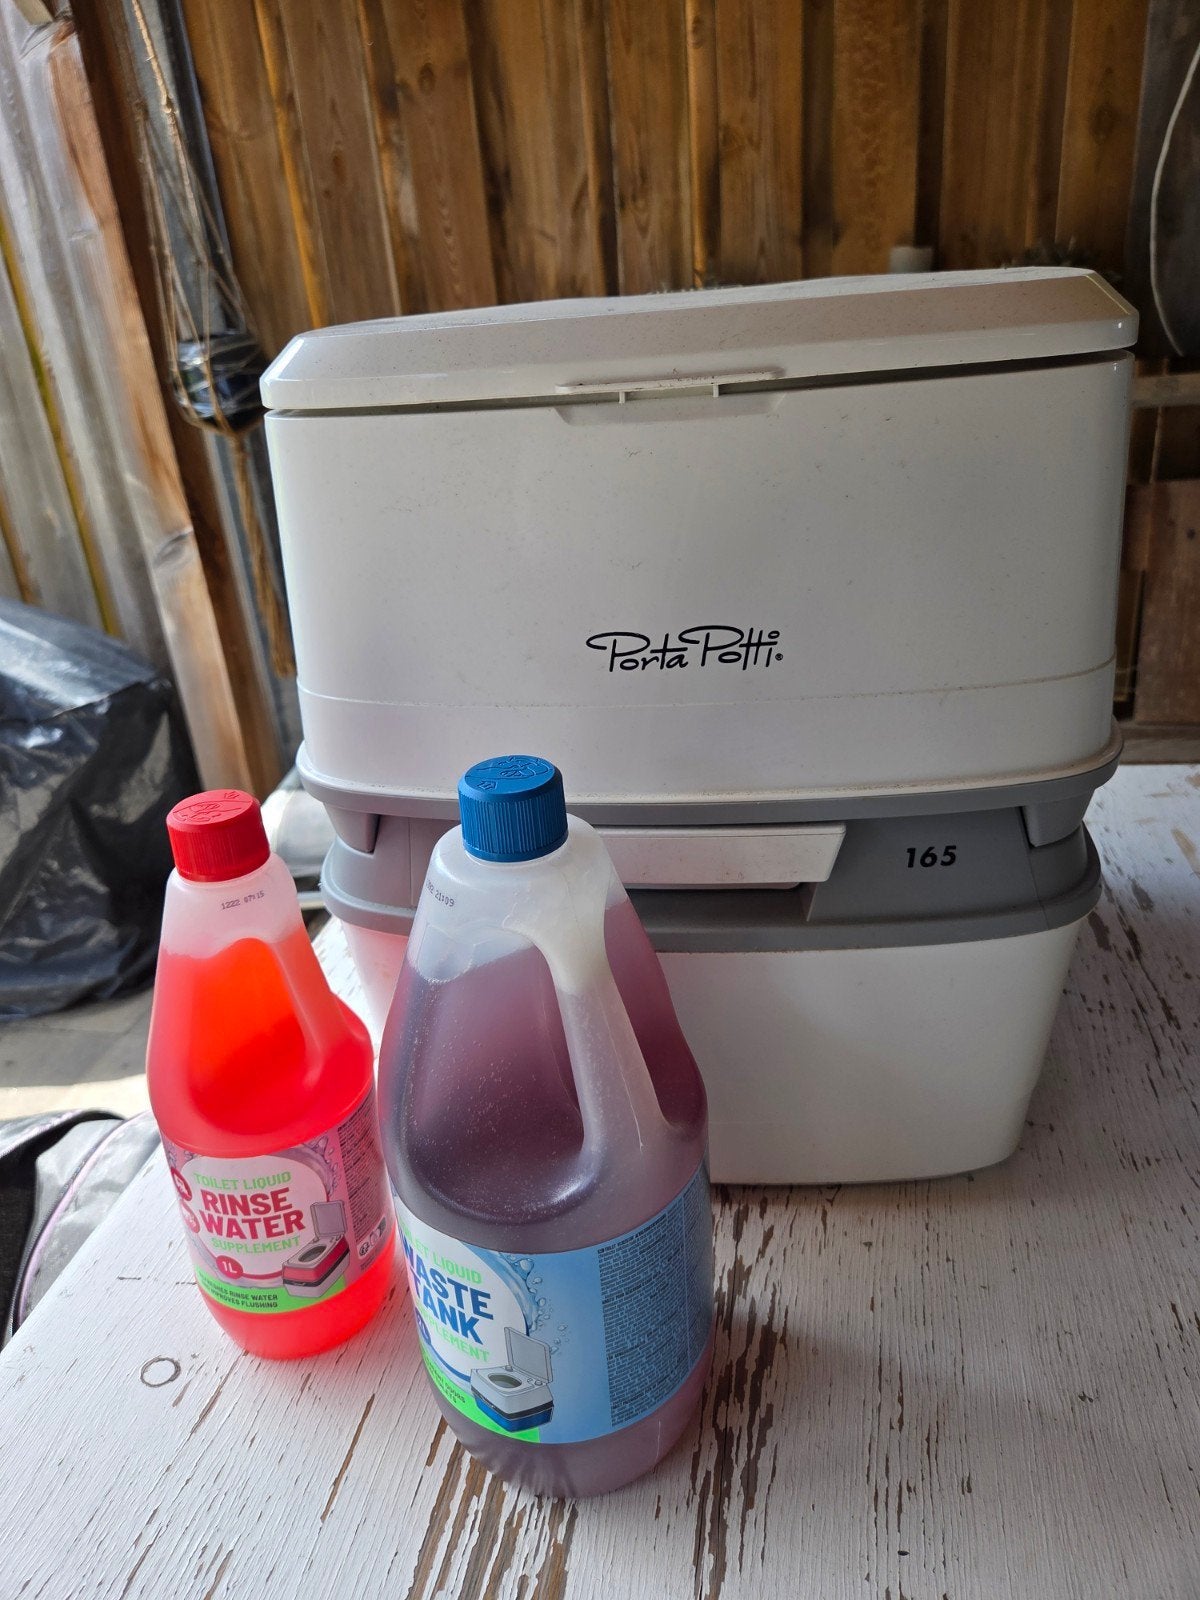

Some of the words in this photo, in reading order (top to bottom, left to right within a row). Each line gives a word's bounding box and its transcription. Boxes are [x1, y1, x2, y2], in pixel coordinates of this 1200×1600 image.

[586, 631, 689, 672] Porta
[905, 845, 957, 868] 165
[193, 1172, 239, 1190] TOILET
[243, 1171, 292, 1190] LIQUID
[200, 1187, 293, 1217] RINSE
[199, 1209, 306, 1240] WATER
[210, 1236, 300, 1254] SUPPLEMENT
[221, 1259, 238, 1274] 1L
[399, 1227, 494, 1320] WASTE
[432, 1251, 482, 1284] LIQUID
[229, 1290, 250, 1300] RINSE
[241, 1300, 278, 1309] FLUSHING
[410, 1265, 484, 1345] TANK
